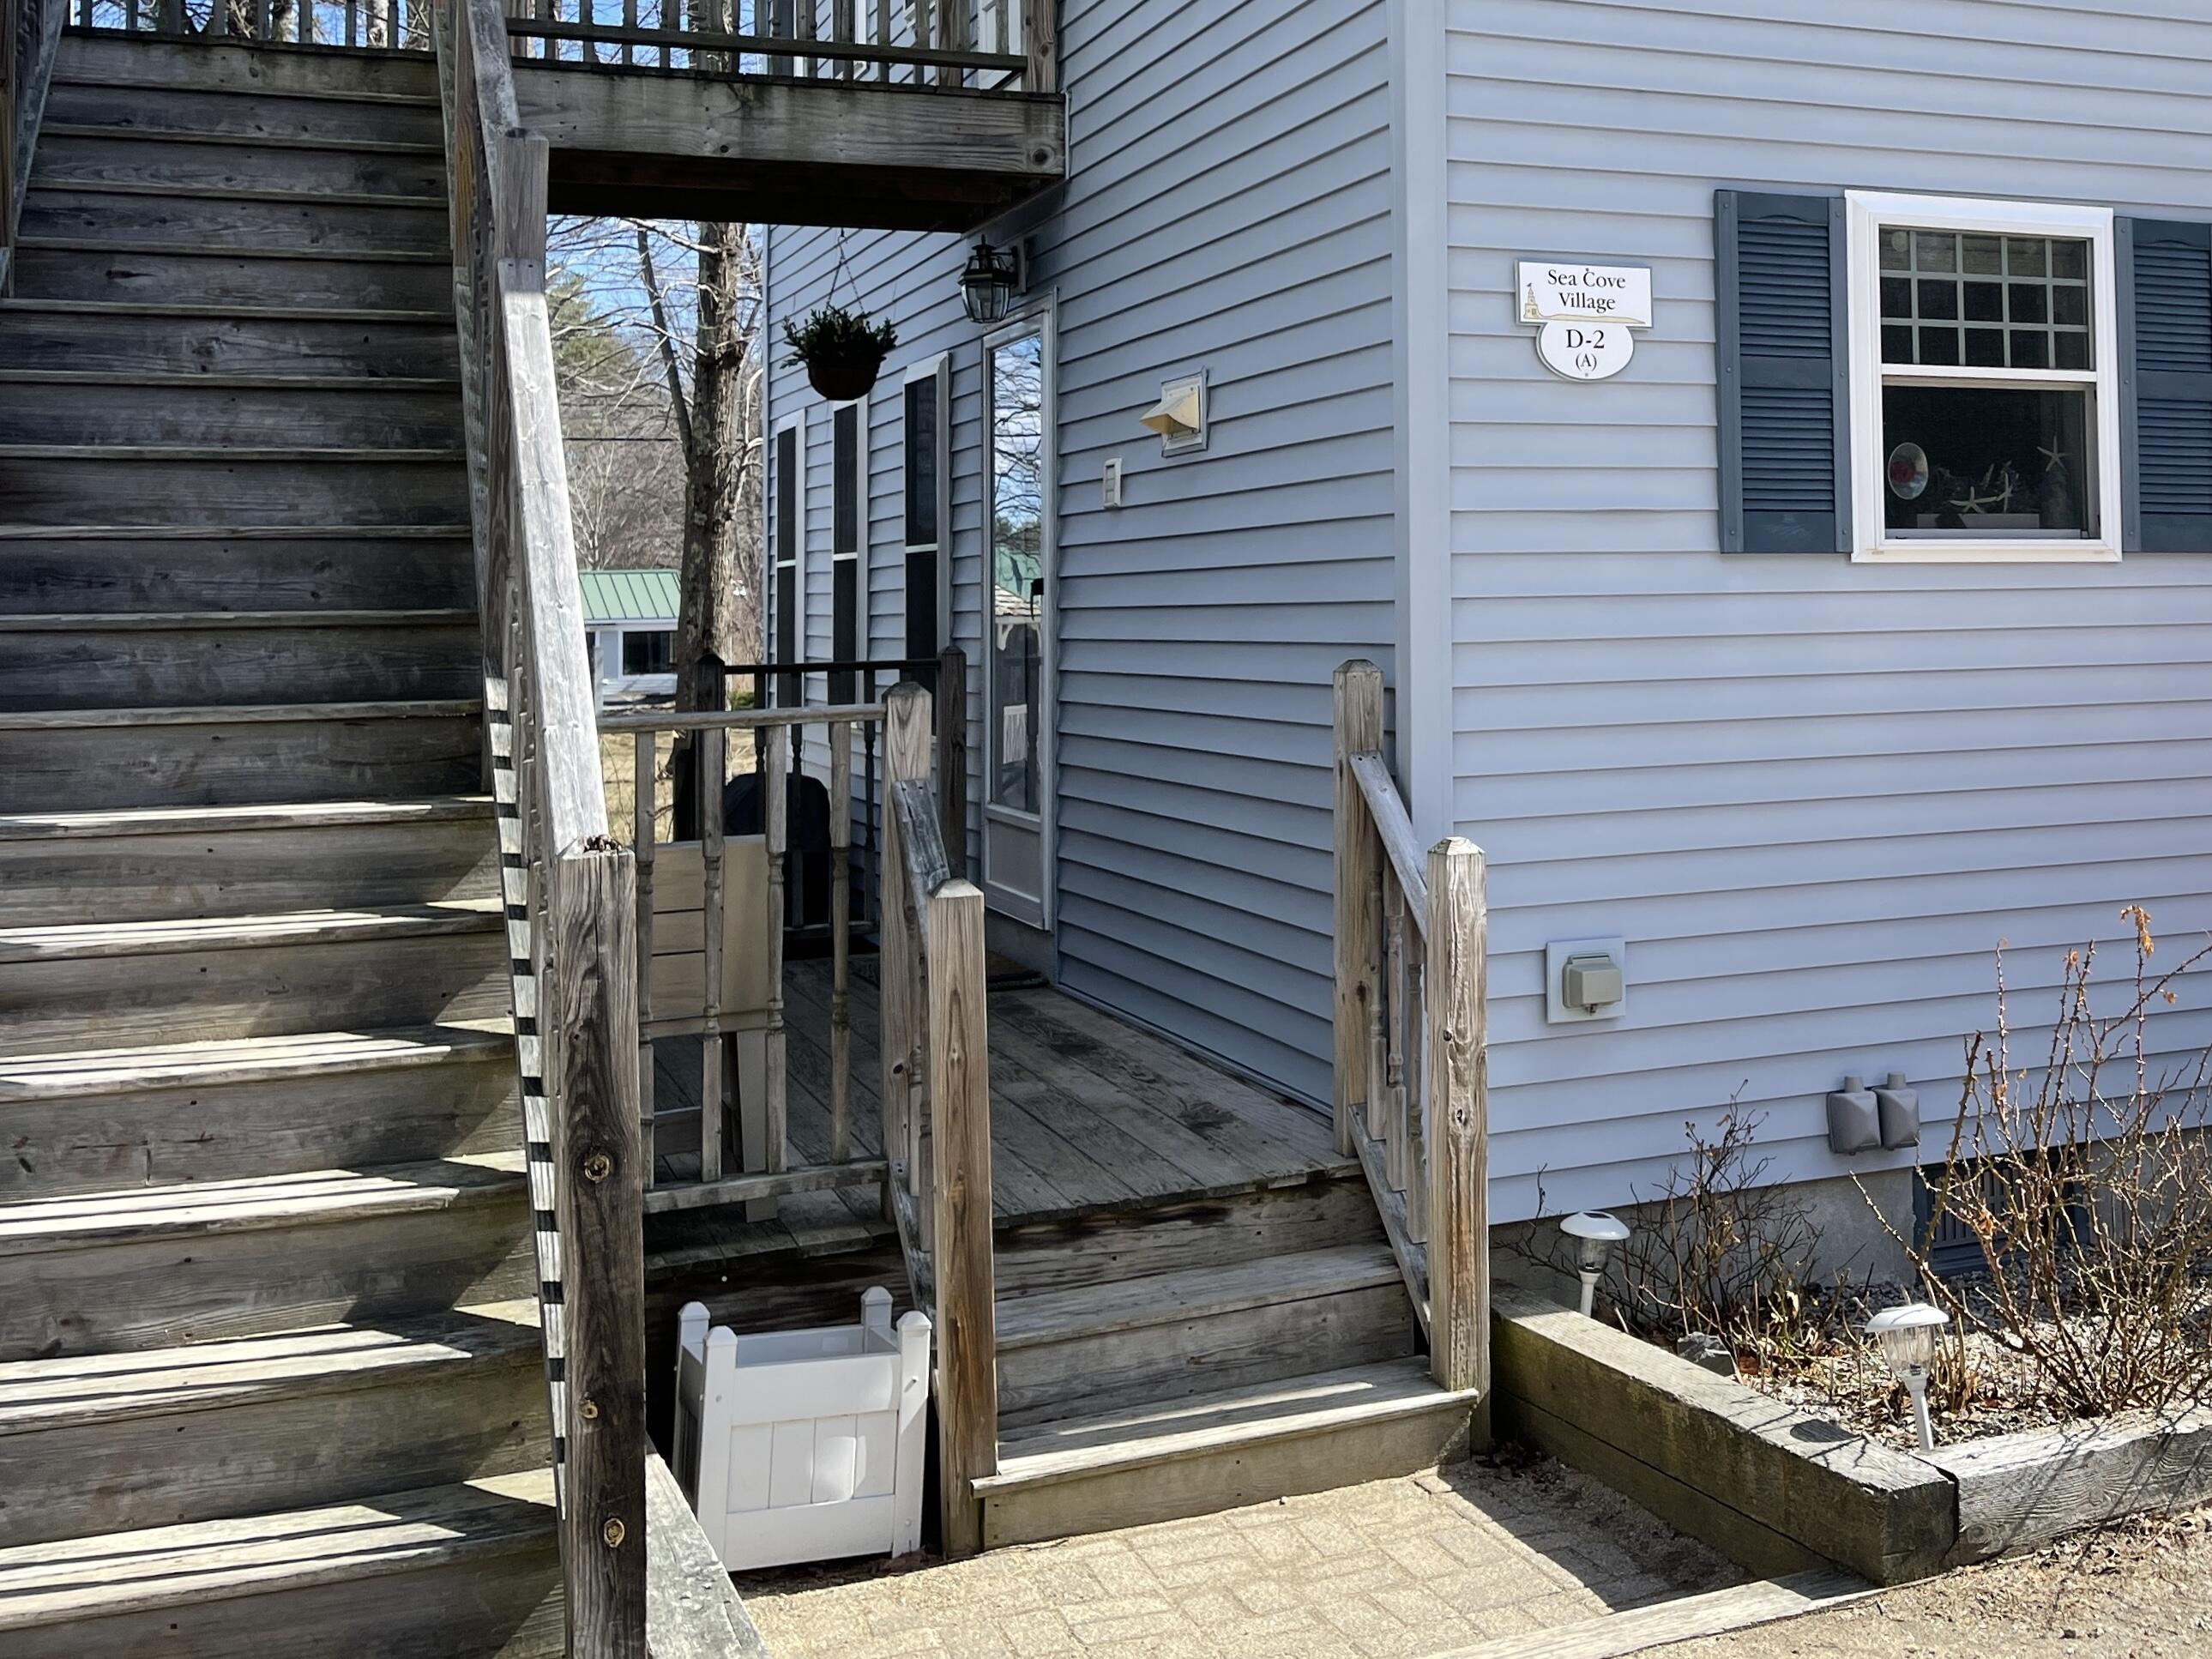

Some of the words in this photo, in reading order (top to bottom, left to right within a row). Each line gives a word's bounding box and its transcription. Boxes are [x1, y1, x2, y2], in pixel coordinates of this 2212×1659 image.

[1547, 268, 1577, 287] Sea
[1582, 271, 1626, 289] Cove
[1558, 292, 1616, 314] Village
[1565, 329, 1605, 349] D-2
[1575, 353, 1597, 371] (A)
